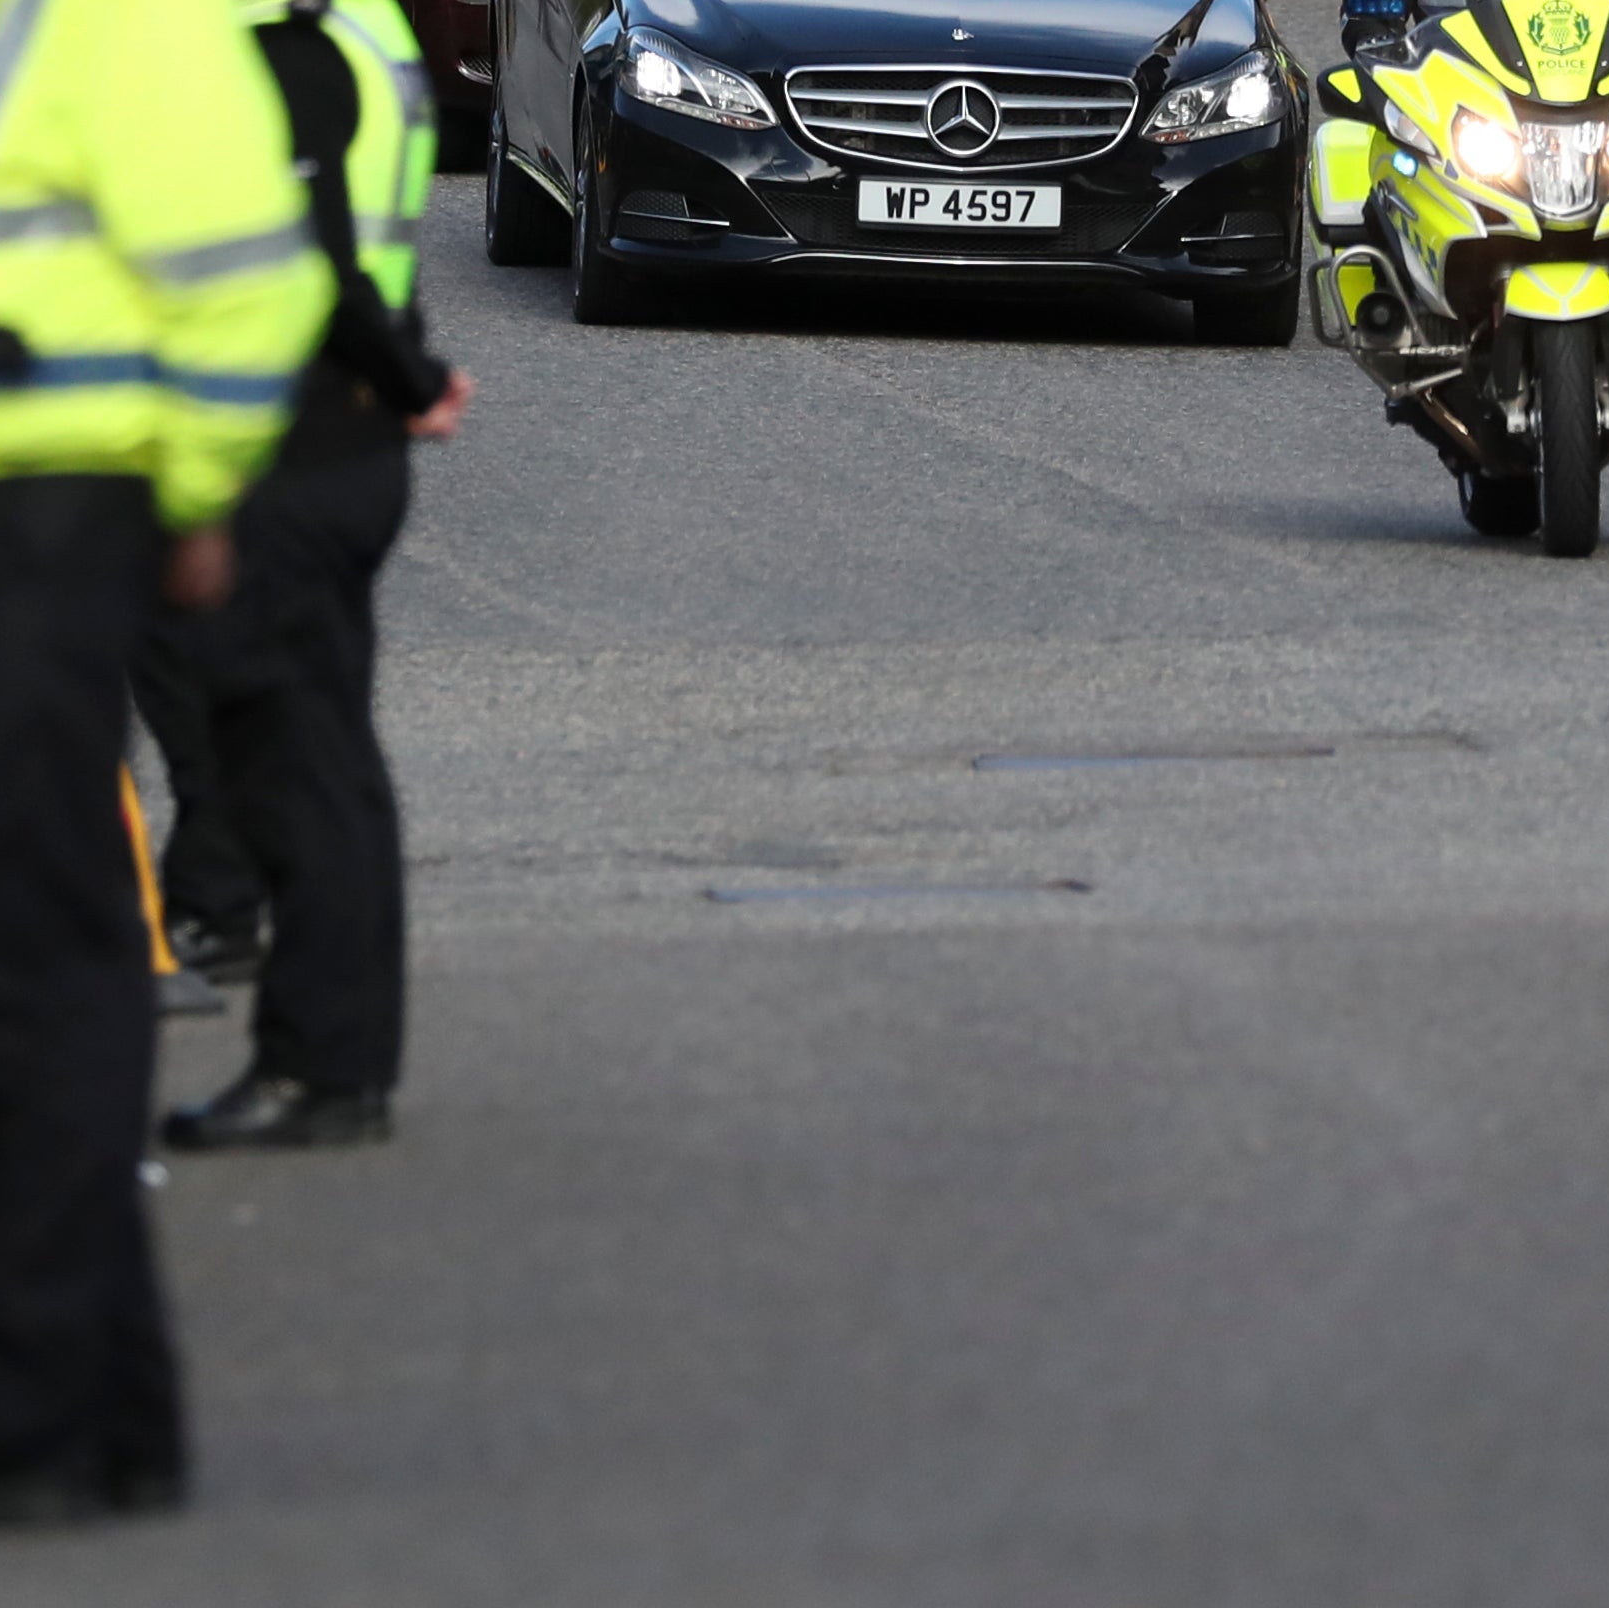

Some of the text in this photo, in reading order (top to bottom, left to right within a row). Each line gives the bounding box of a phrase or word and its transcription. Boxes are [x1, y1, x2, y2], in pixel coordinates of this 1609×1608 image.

[1537, 59, 1588, 69] POLICE
[885, 186, 1036, 223] WP 4597
